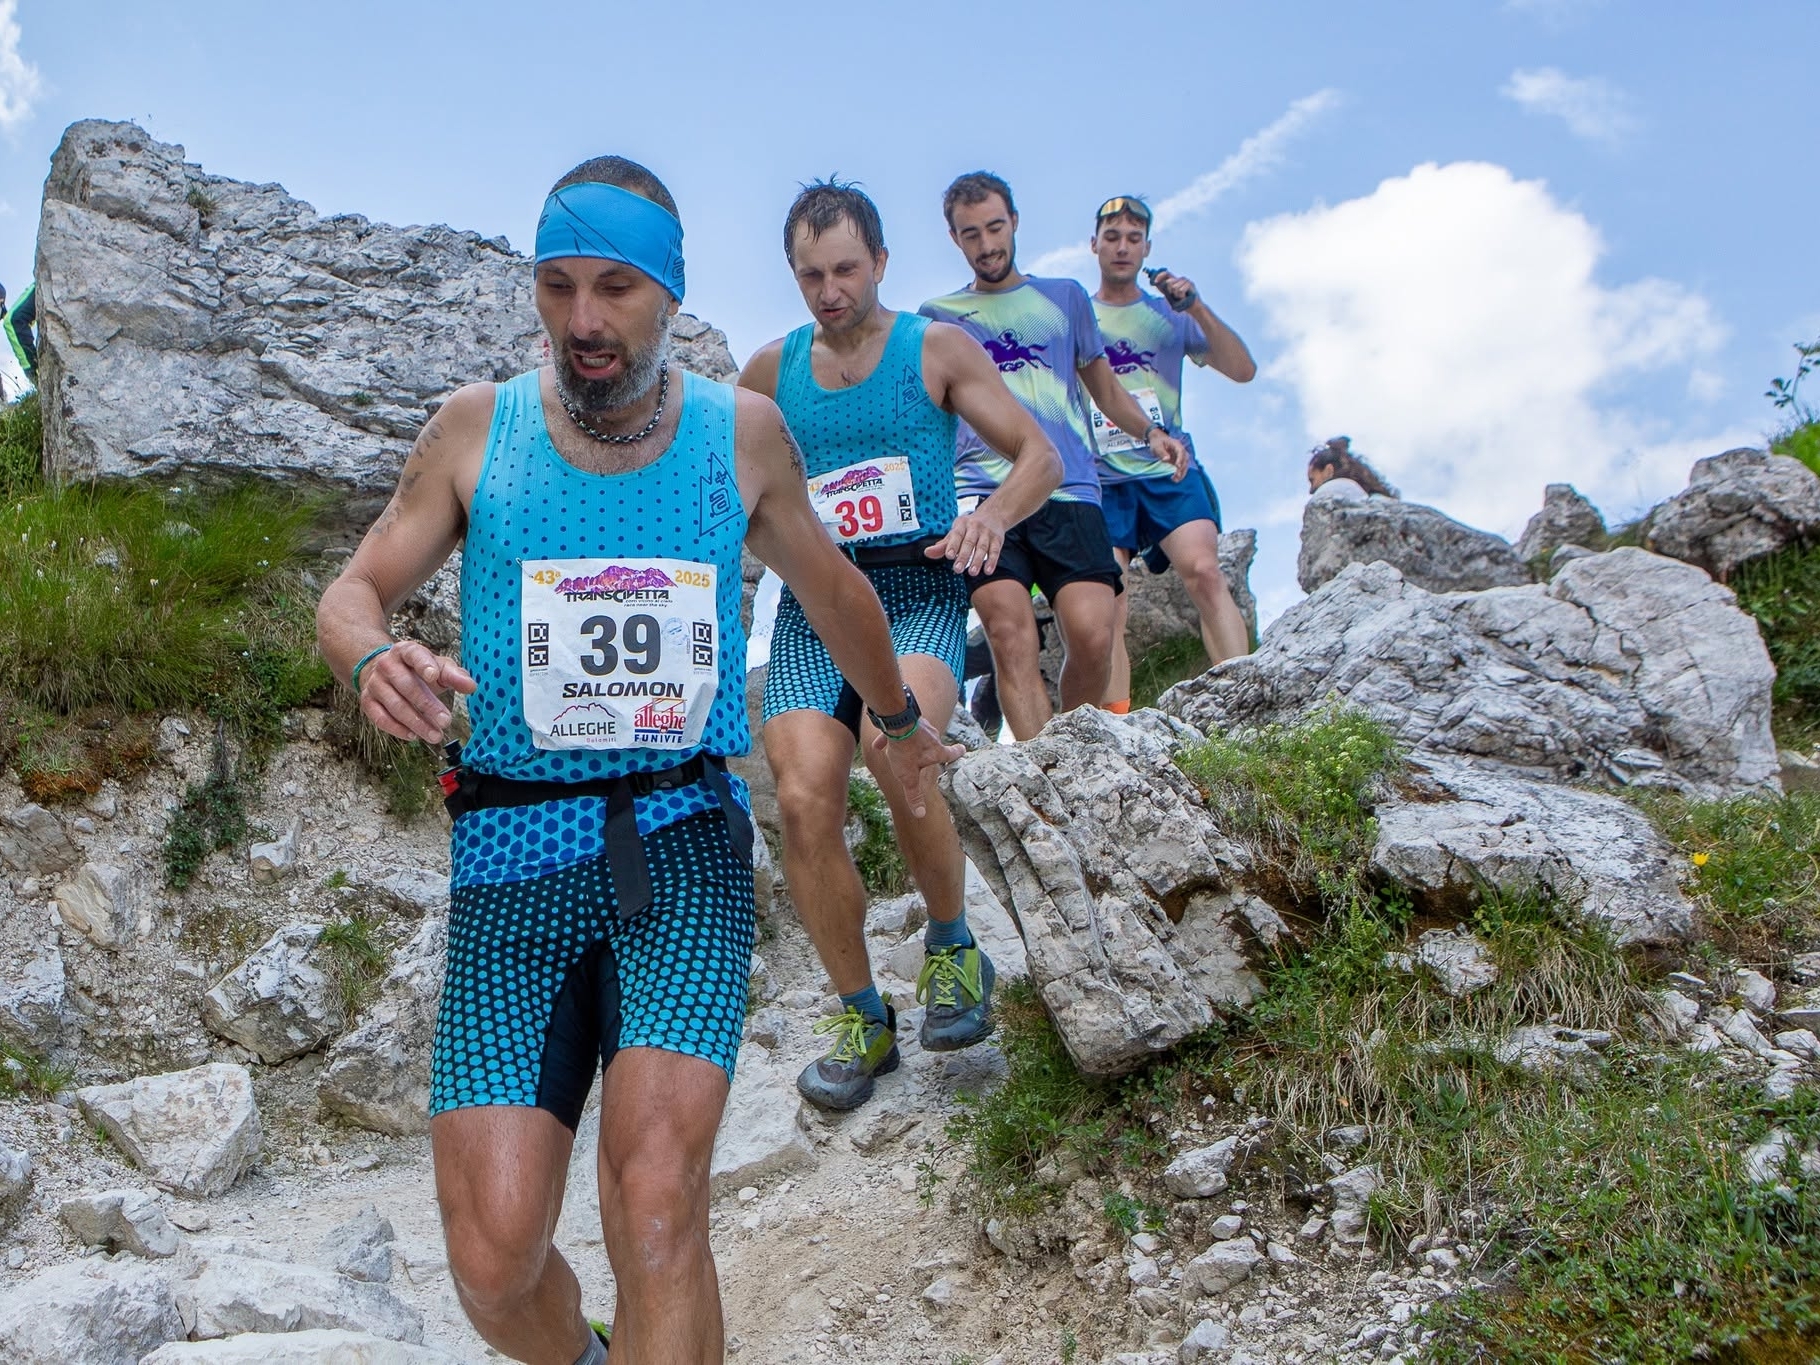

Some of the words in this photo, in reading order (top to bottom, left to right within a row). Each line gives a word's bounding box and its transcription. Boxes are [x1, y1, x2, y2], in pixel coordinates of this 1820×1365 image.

[835, 495, 884, 538] 39
[675, 569, 711, 588] 2025
[563, 589, 669, 603] TRANSCIVETTA
[580, 614, 661, 676] 39
[562, 681, 684, 699] SALOMON
[634, 705, 686, 731] alleghe
[550, 721, 616, 737] ALLEGHE
[634, 734, 683, 744] FUNIVIE
